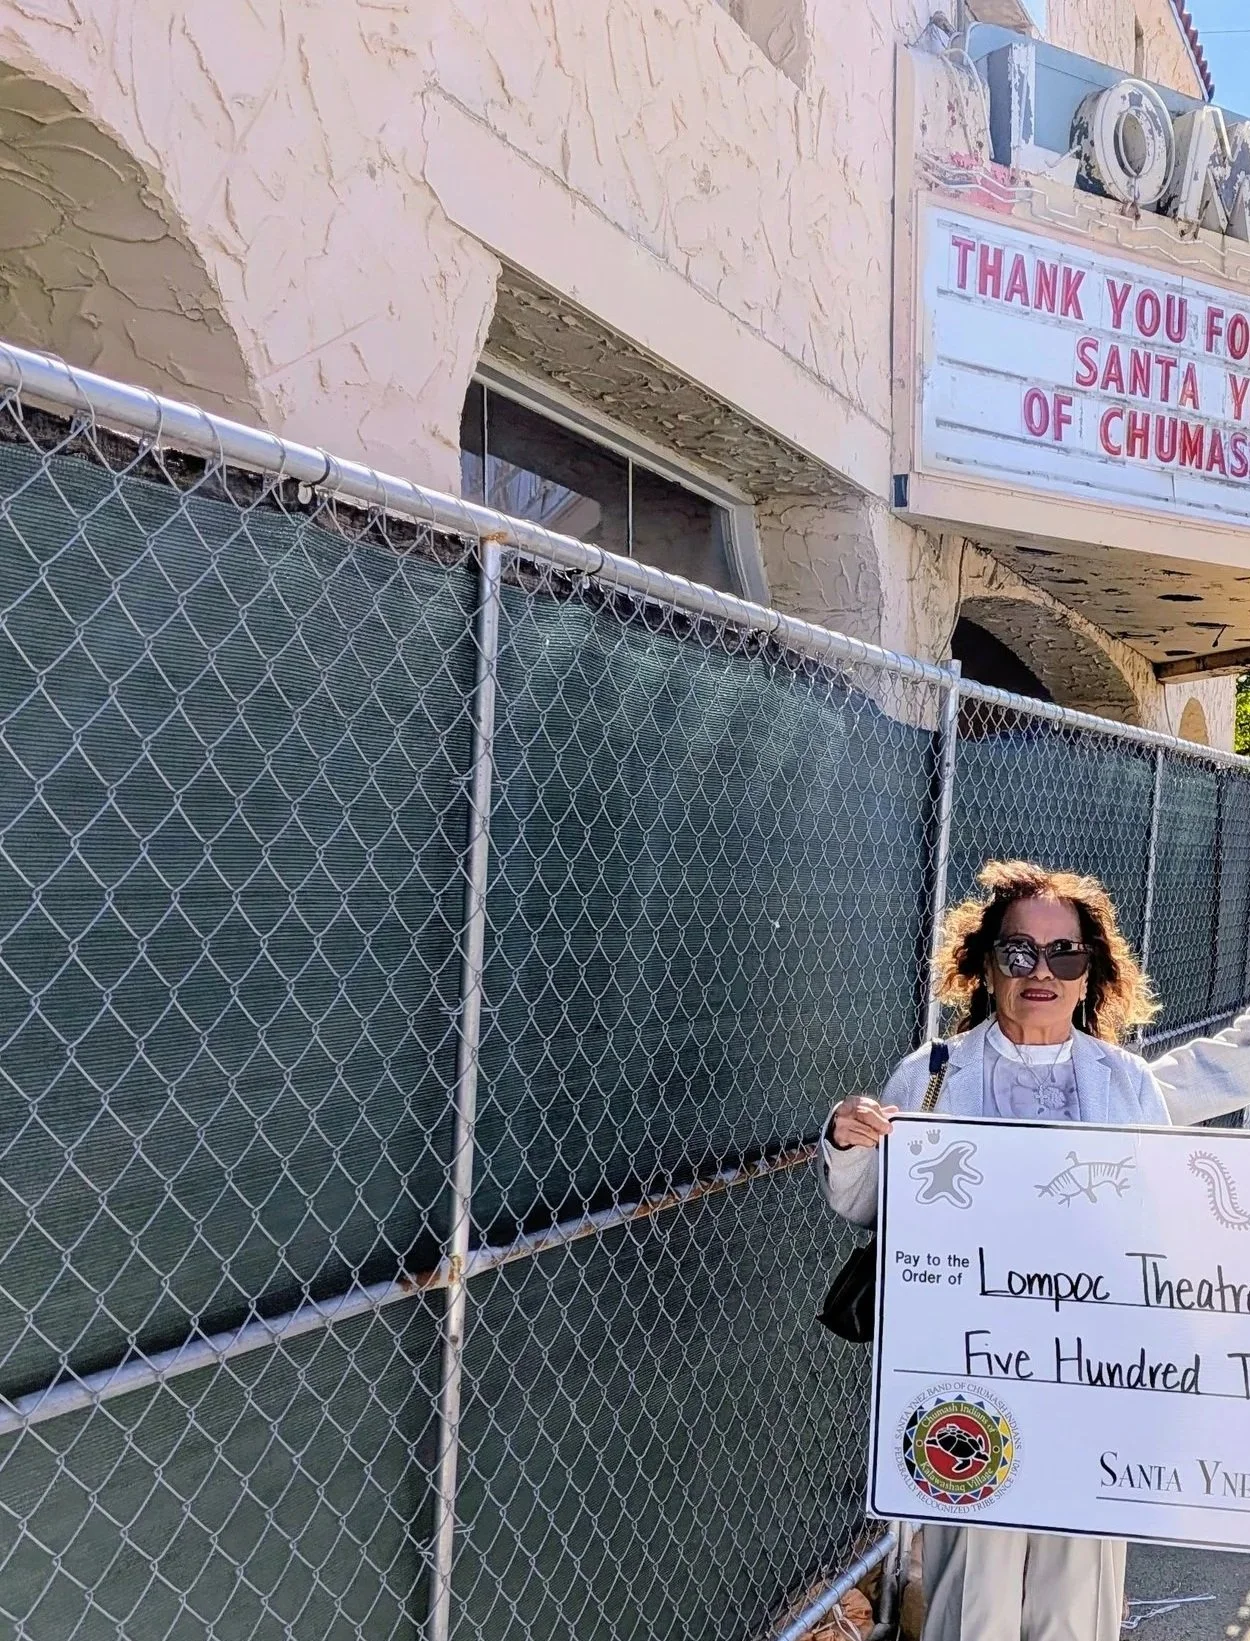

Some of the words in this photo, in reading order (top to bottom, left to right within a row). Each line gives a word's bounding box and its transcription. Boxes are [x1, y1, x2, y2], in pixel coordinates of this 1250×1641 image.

[952, 235, 1085, 320] THANK
[1106, 278, 1187, 343] YOU
[1075, 337, 1199, 410] SANTA
[1023, 387, 1073, 441] OF
[896, 1251, 920, 1268] Pay
[927, 1253, 941, 1267] to
[947, 1254, 970, 1268] the
[902, 1269, 942, 1284] Order
[948, 1272, 963, 1285] of
[978, 1247, 1110, 1312] Lompoc
[965, 1330, 1034, 1379] Five
[1055, 1336, 1200, 1395] Hundred
[895, 1411, 911, 1440] SANTA
[908, 1392, 926, 1410] YNEZ
[927, 1383, 952, 1396] BAND
[954, 1382, 966, 1390] OF
[967, 1384, 1007, 1413] CHUMASH
[1005, 1411, 1021, 1449] INDIANS
[921, 1403, 958, 1428] Chumash
[961, 1403, 989, 1424] Indians
[987, 1424, 998, 1433] of
[895, 1446, 918, 1492] FEDERALLY
[916, 1492, 970, 1514] RECOGNIZED
[970, 1498, 995, 1512] TRIBE
[994, 1476, 1014, 1500] SINCE
[966, 1468, 994, 1488] Village
[1099, 1451, 1184, 1492] SANTA
